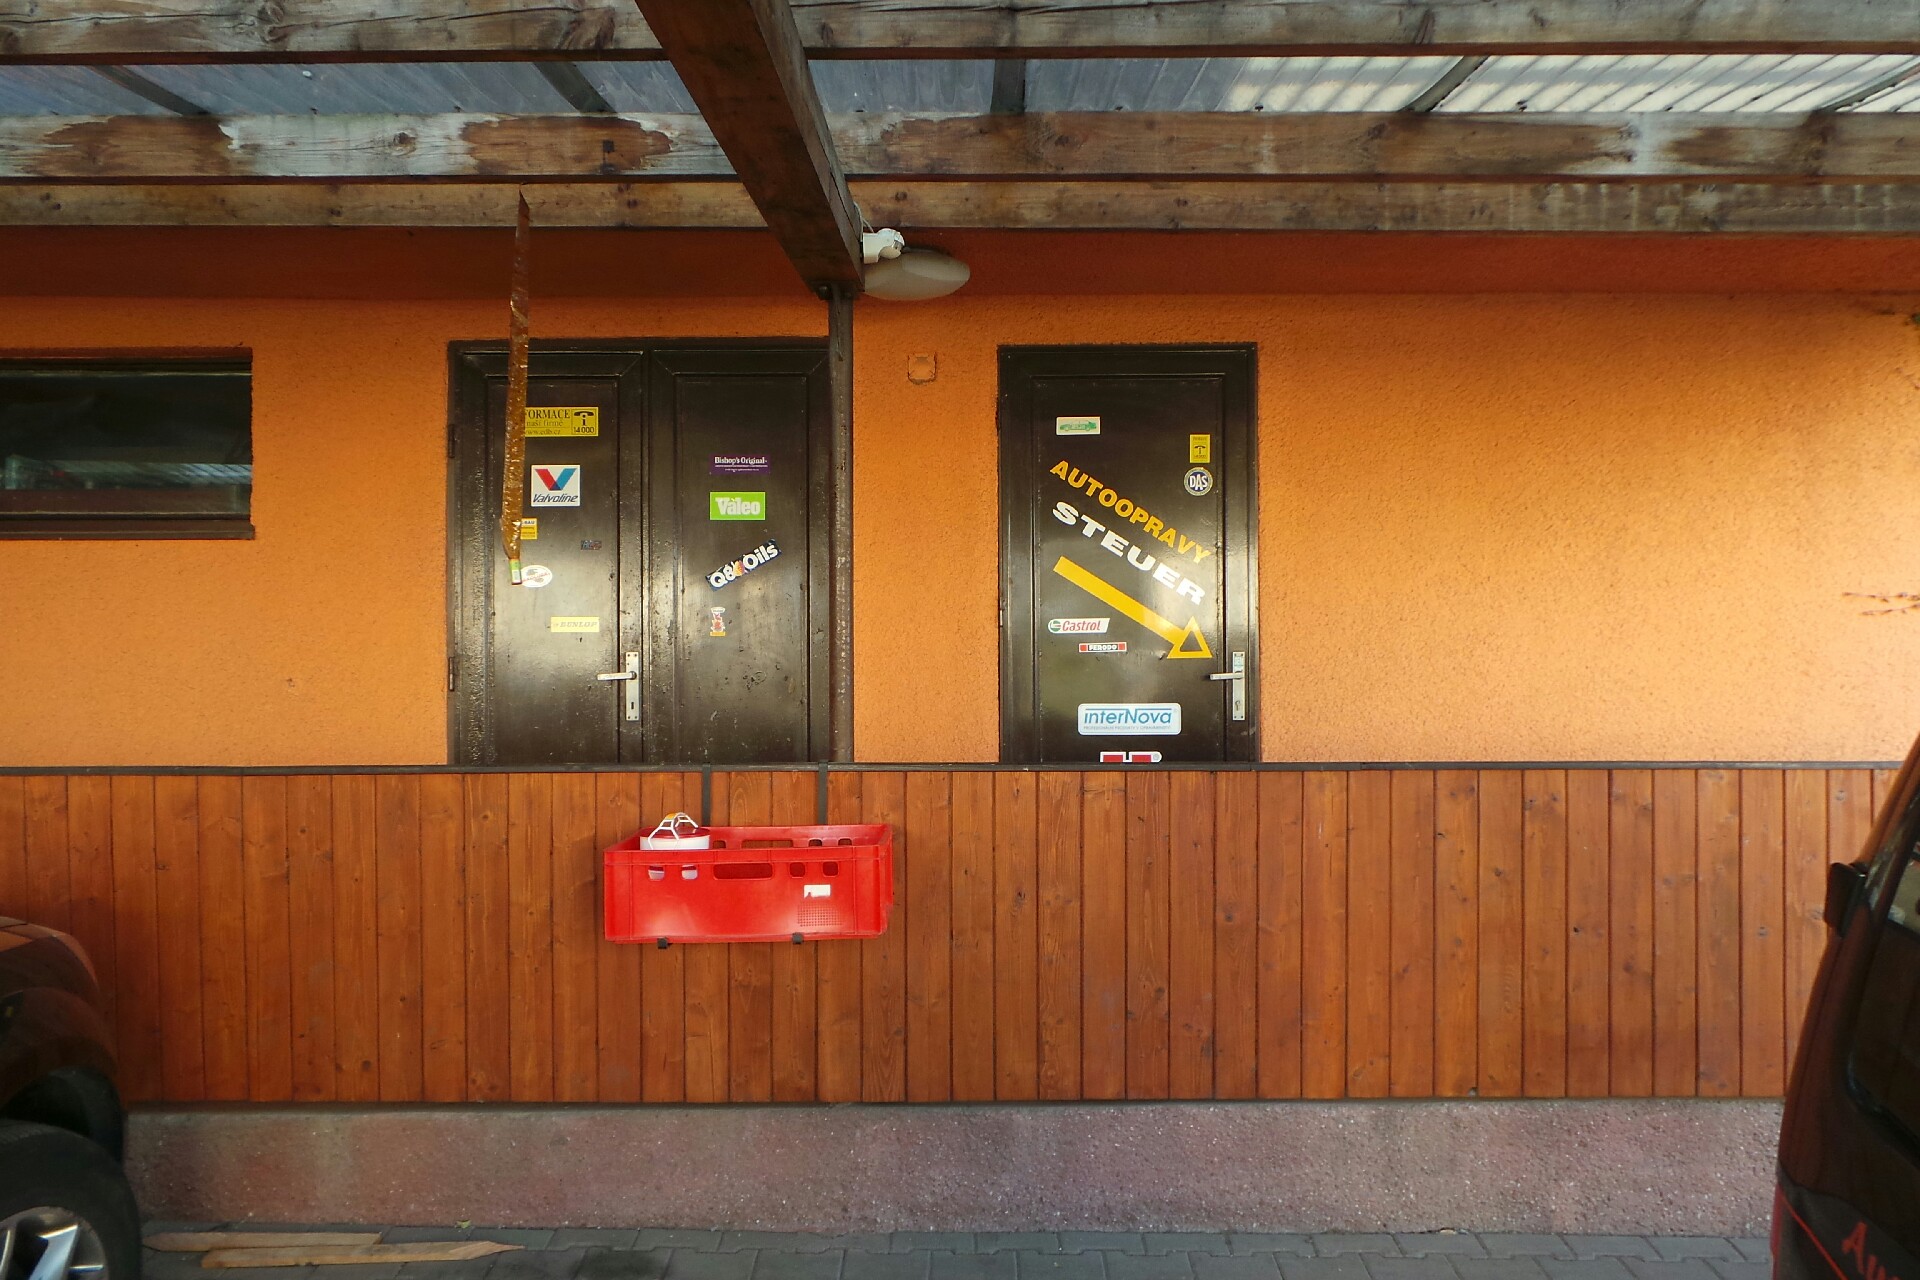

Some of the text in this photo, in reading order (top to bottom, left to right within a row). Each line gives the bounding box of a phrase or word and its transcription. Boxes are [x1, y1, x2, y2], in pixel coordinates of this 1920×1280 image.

[526, 409, 570, 419] ORMACE
[714, 456, 765, 465] Bishop's Original
[1189, 473, 1208, 491] DAS
[533, 493, 579, 503] Valvoline
[715, 497, 761, 516] Valeo
[1050, 460, 1212, 564] AUTOOPRAVY
[1052, 501, 1206, 606] STEUER
[709, 543, 779, 589] Q8 Oils
[1062, 620, 1101, 632] Castrol
[1084, 708, 1172, 724] interNova
